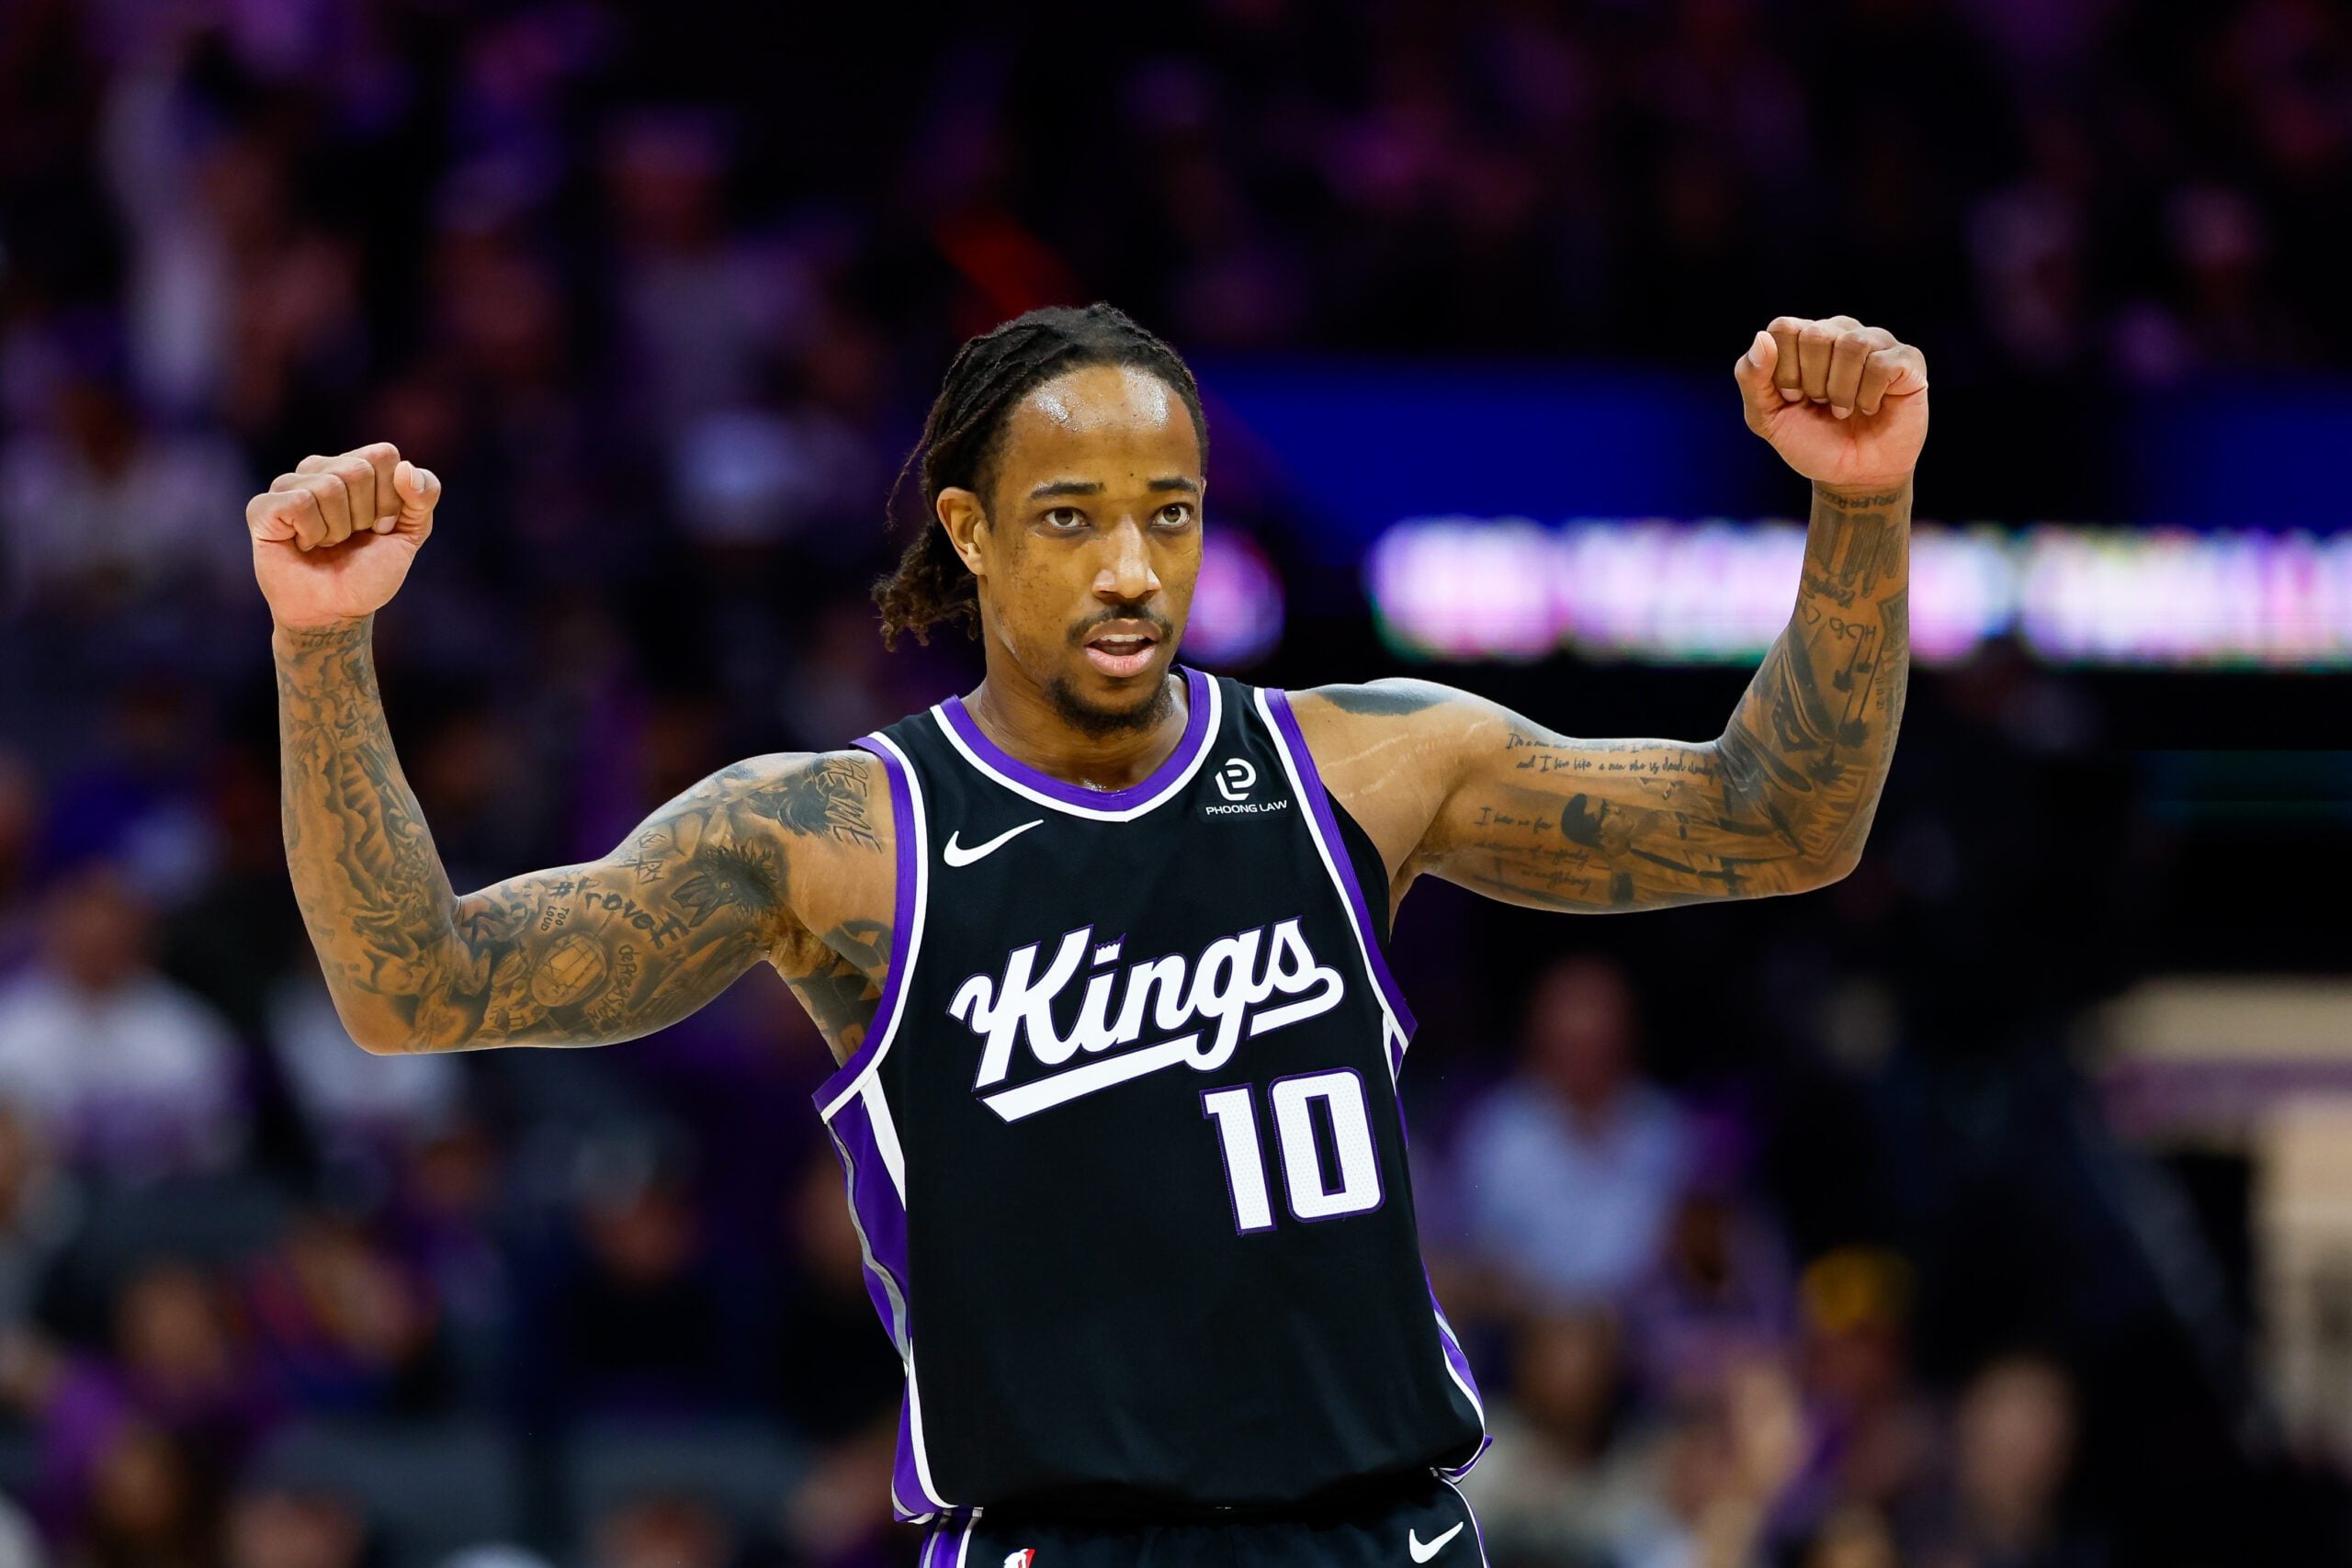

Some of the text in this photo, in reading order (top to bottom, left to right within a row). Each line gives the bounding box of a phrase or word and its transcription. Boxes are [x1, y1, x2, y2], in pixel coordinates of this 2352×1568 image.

[1539, 754, 1553, 773] I
[1205, 799, 1287, 816] PHOONG LAW
[540, 905, 558, 931] LOUD
[554, 907, 570, 927] TOO
[947, 916, 1345, 1123] Kings
[1199, 1067, 1385, 1235] 10
